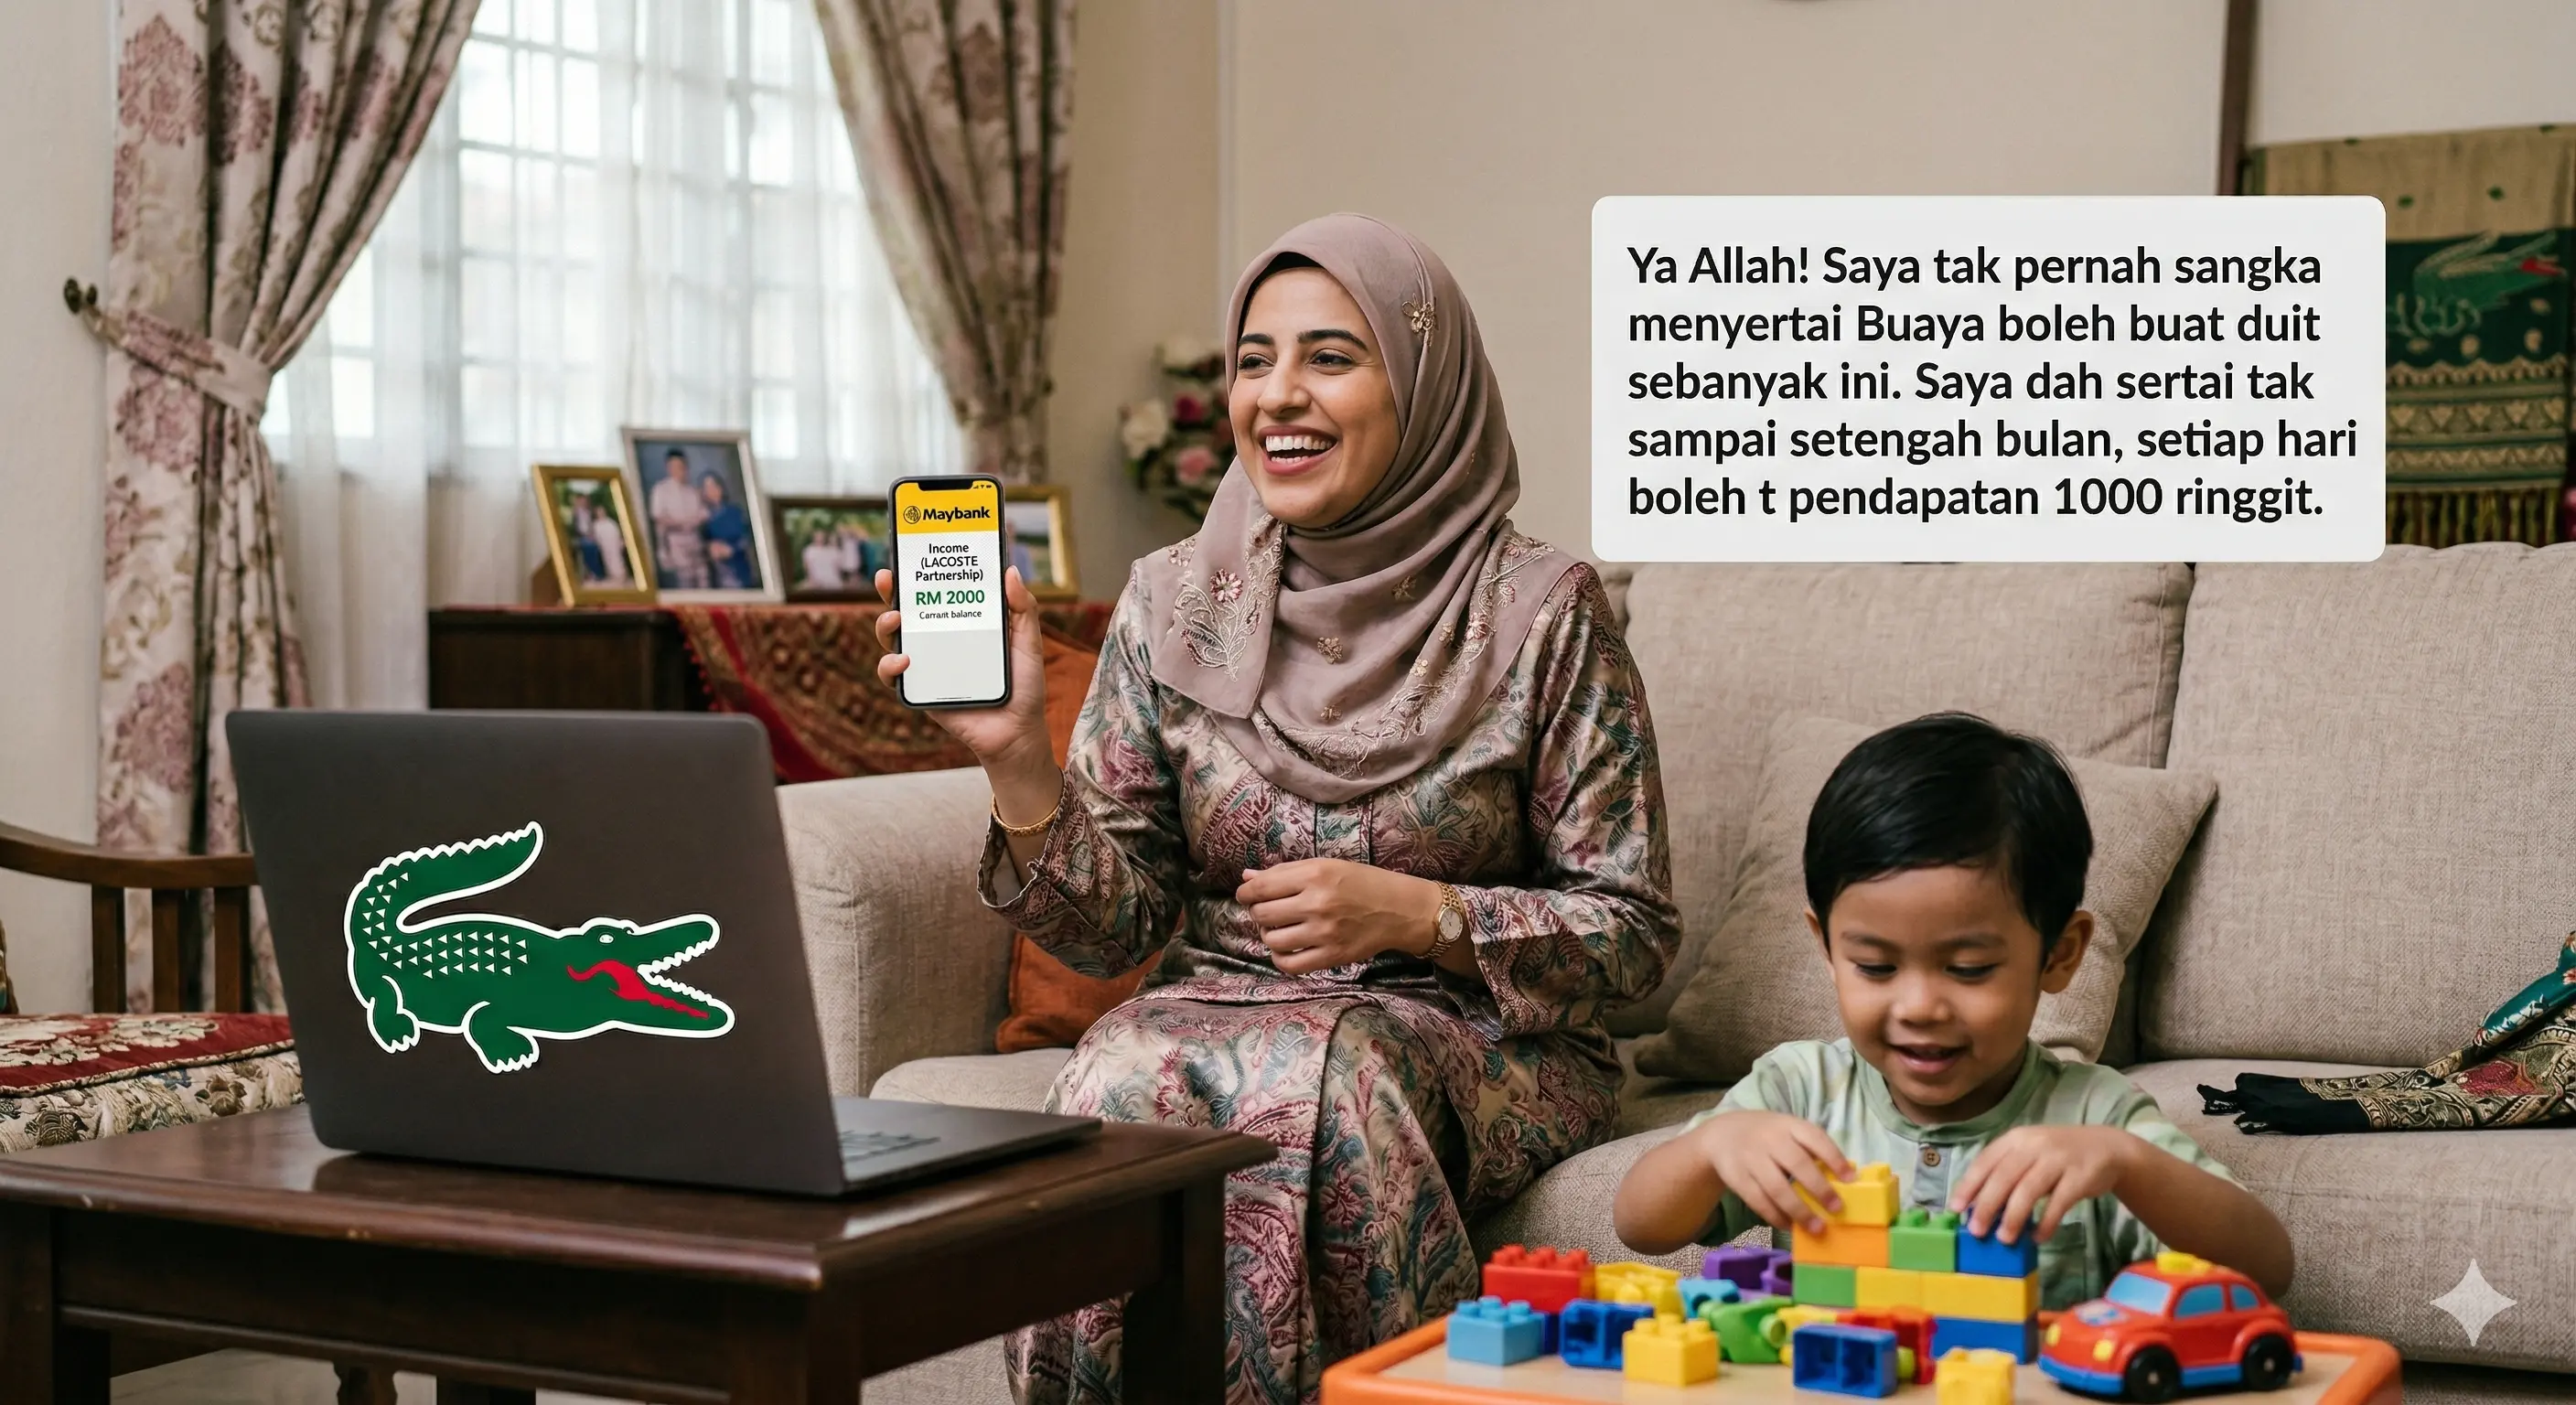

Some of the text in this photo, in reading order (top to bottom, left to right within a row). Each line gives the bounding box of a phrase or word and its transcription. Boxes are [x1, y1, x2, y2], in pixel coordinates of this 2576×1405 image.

[922, 506, 991, 522] Maybank
[928, 543, 970, 553] Income
[921, 555, 979, 570] (LACOSTE
[916, 569, 983, 582] Partnership)
[916, 590, 985, 606] RM 2000
[950, 610, 982, 618] balance
